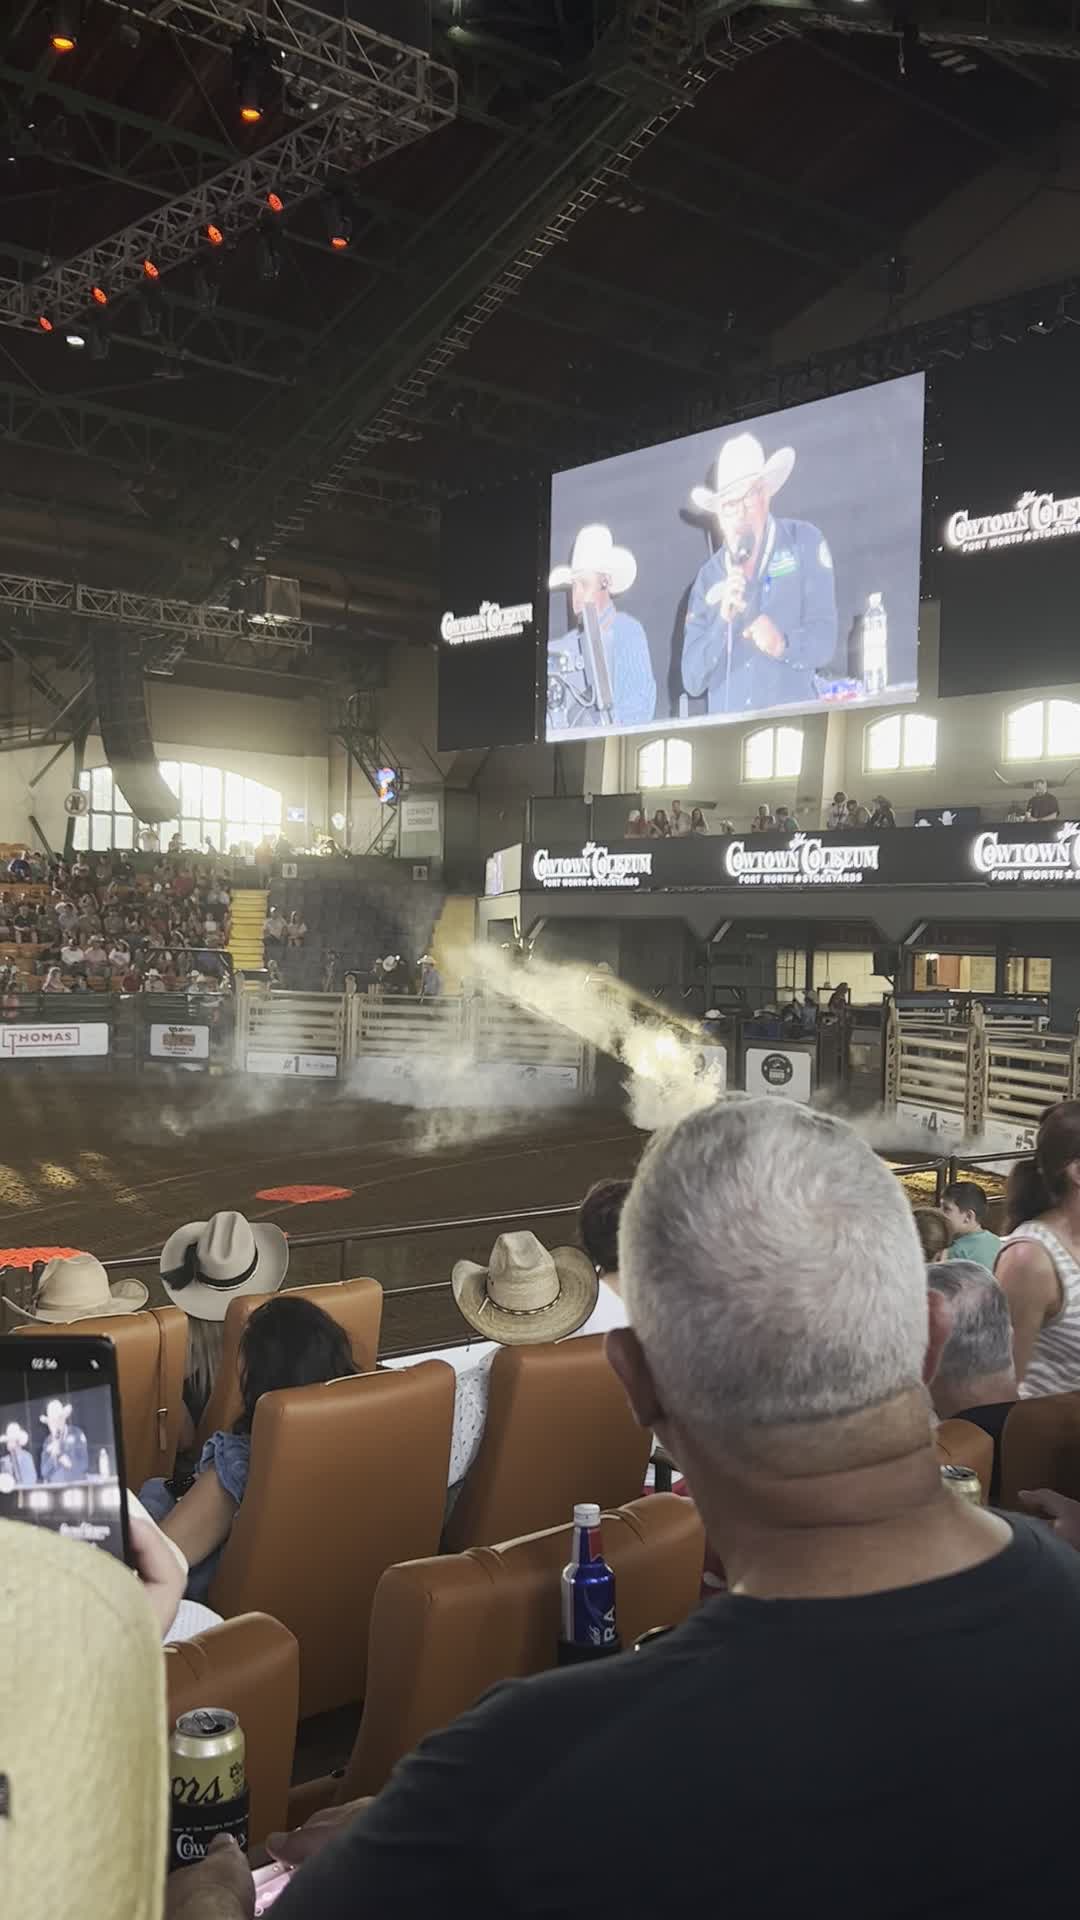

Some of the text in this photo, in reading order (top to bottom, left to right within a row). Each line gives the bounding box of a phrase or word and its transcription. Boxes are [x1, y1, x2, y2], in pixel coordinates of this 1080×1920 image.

[947, 492, 1080, 546] COWTOWN COLIS
[962, 540, 987, 552] FORT
[989, 533, 1024, 549] WORTH
[533, 846, 652, 881] COWTOWN COLISEUM
[725, 838, 880, 877] COWTOWN COLISEUM
[974, 832, 1071, 873] COWTOWN
[543, 878, 561, 888] FORT
[562, 878, 587, 888] WORTH
[739, 872, 863, 884] FORT WORTH STOCKYARDS
[991, 870, 1020, 880] FORT
[1023, 869, 1064, 880] WORTH
[8, 1032, 73, 1055] THOMAS
[171, 1775, 224, 1805] ors
